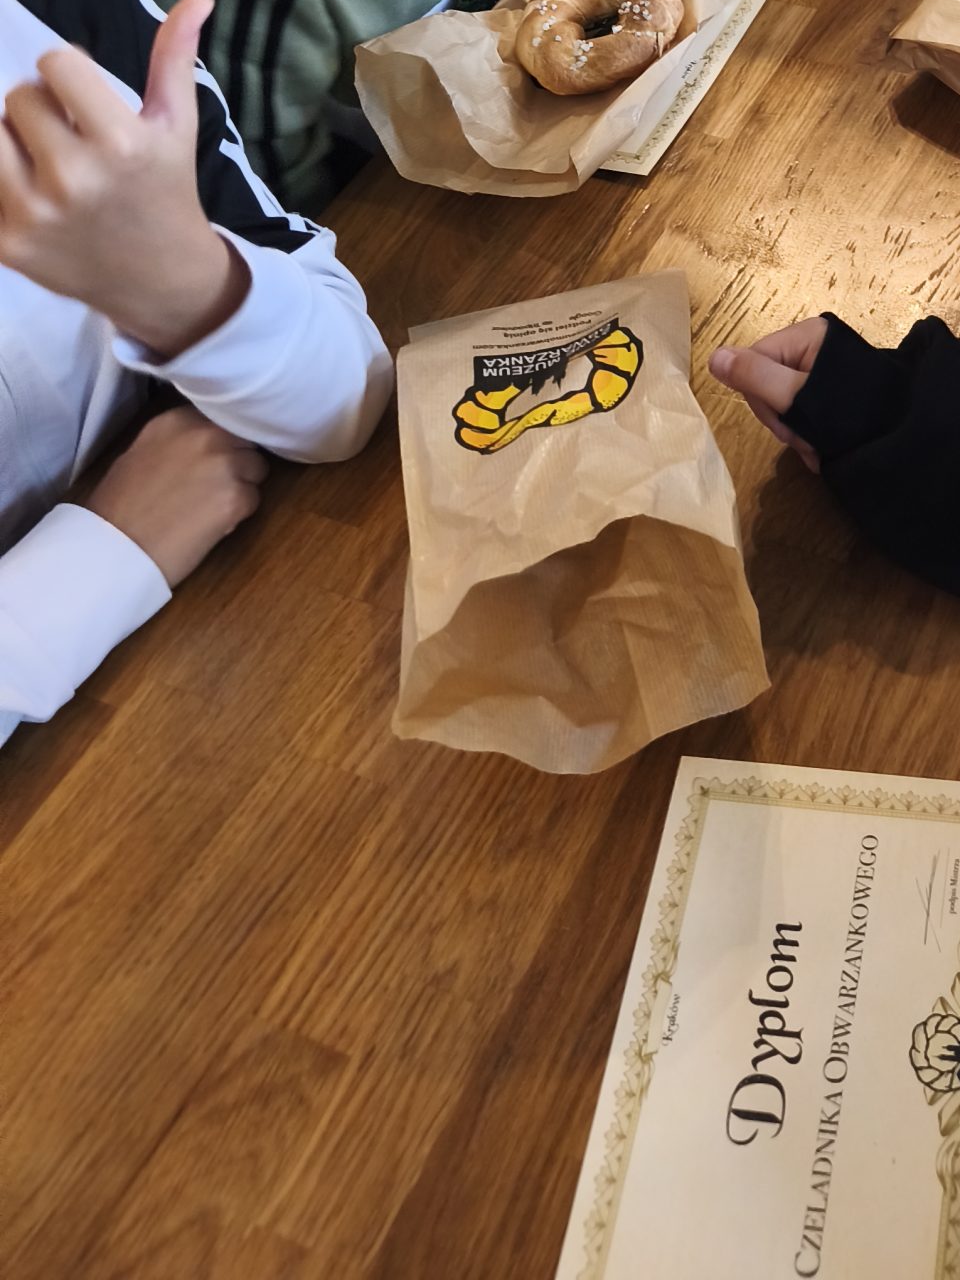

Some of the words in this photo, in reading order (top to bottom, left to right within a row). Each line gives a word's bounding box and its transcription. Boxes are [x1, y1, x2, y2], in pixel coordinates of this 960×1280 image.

[482, 358, 560, 378] MUZEUM
[949, 858, 960, 886] Mistrza
[661, 993, 680, 1046] Kraków
[726, 920, 803, 1146] Dyplom
[794, 1091, 844, 1279] CZELADNIKA
[822, 833, 879, 1083] OBWARZANKOWEGO
